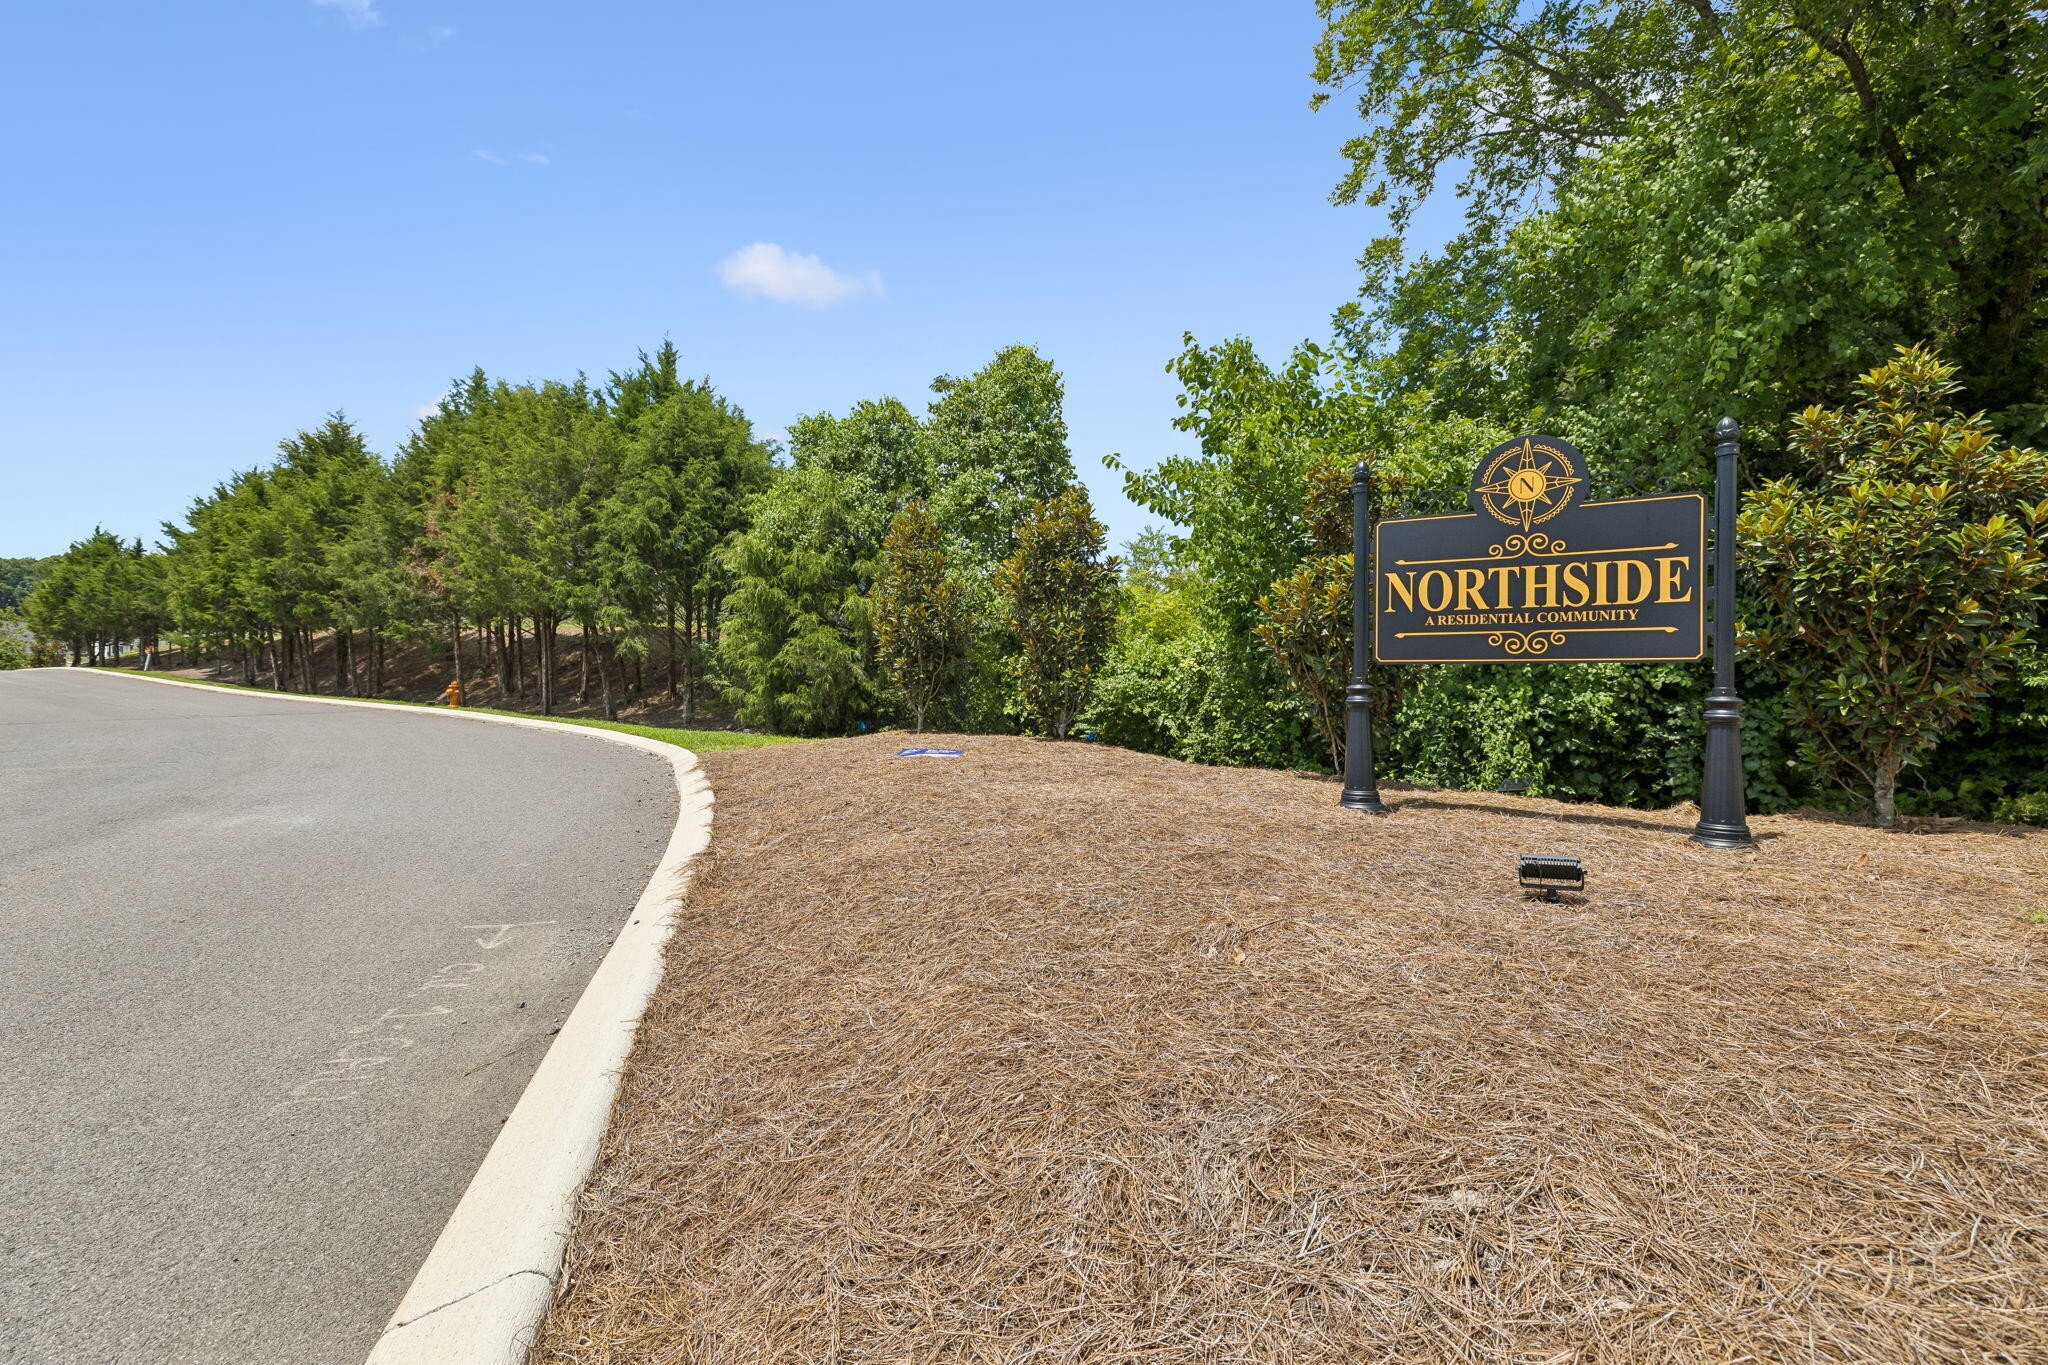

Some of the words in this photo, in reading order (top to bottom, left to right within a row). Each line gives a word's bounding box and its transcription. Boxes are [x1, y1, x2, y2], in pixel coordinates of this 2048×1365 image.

[1520, 476, 1535, 494] N
[1384, 556, 1693, 613] NORTHSIDE
[1424, 615, 1435, 626] A
[1437, 612, 1534, 626] RESIDENTIAL
[1536, 608, 1639, 623] COMMUNITY
